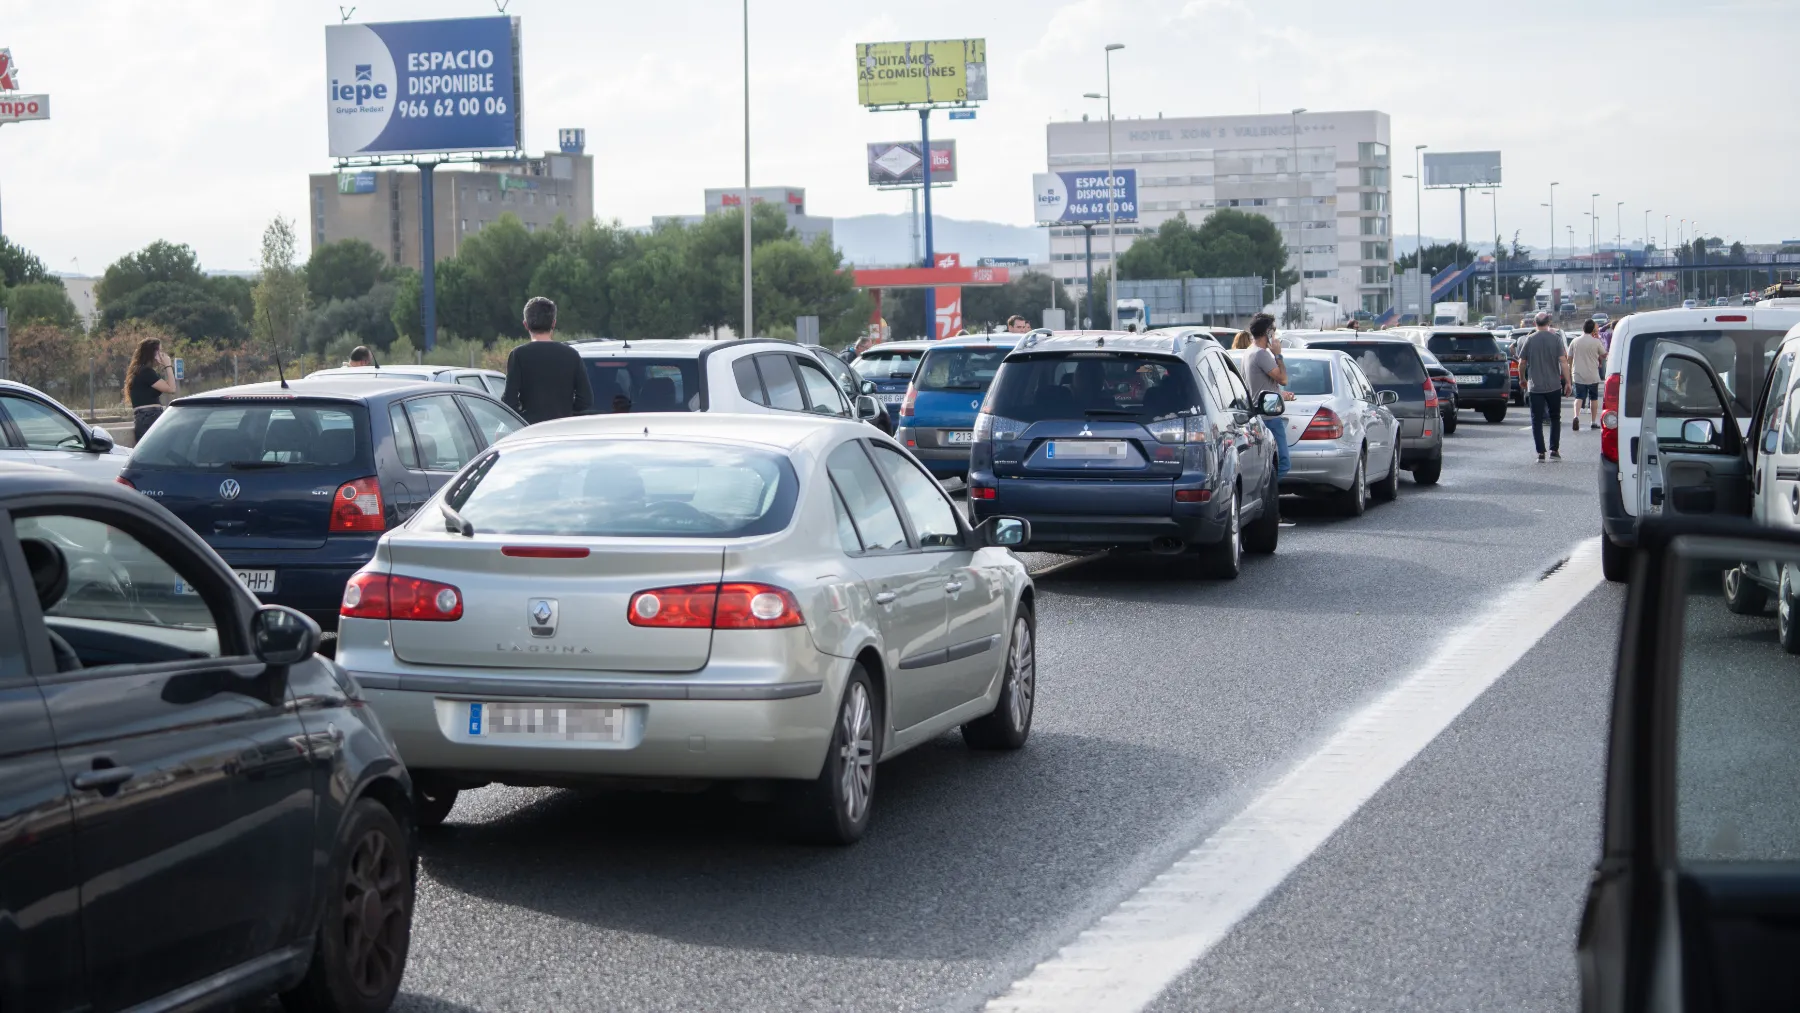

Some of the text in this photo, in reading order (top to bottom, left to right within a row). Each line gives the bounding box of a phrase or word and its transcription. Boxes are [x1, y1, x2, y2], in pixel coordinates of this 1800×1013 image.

[407, 49, 494, 72] ESPACIO
[878, 66, 956, 79] COMISIONES
[408, 73, 494, 96] DISPONIBLE
[332, 79, 388, 106] iepe
[336, 105, 384, 115] Grupo Redext
[399, 97, 507, 118] 966 62 00 06
[1129, 129, 1172, 141] HOTEL
[1233, 124, 1303, 137] VALENCIA
[933, 155, 949, 166] ibis
[1075, 176, 1126, 188] ESPACIO
[1038, 193, 1061, 204] iepe
[1069, 203, 1088, 214] 966
[1091, 202, 1104, 213] 62
[1121, 201, 1135, 212] 06
[496, 643, 592, 654] LAGUNA
